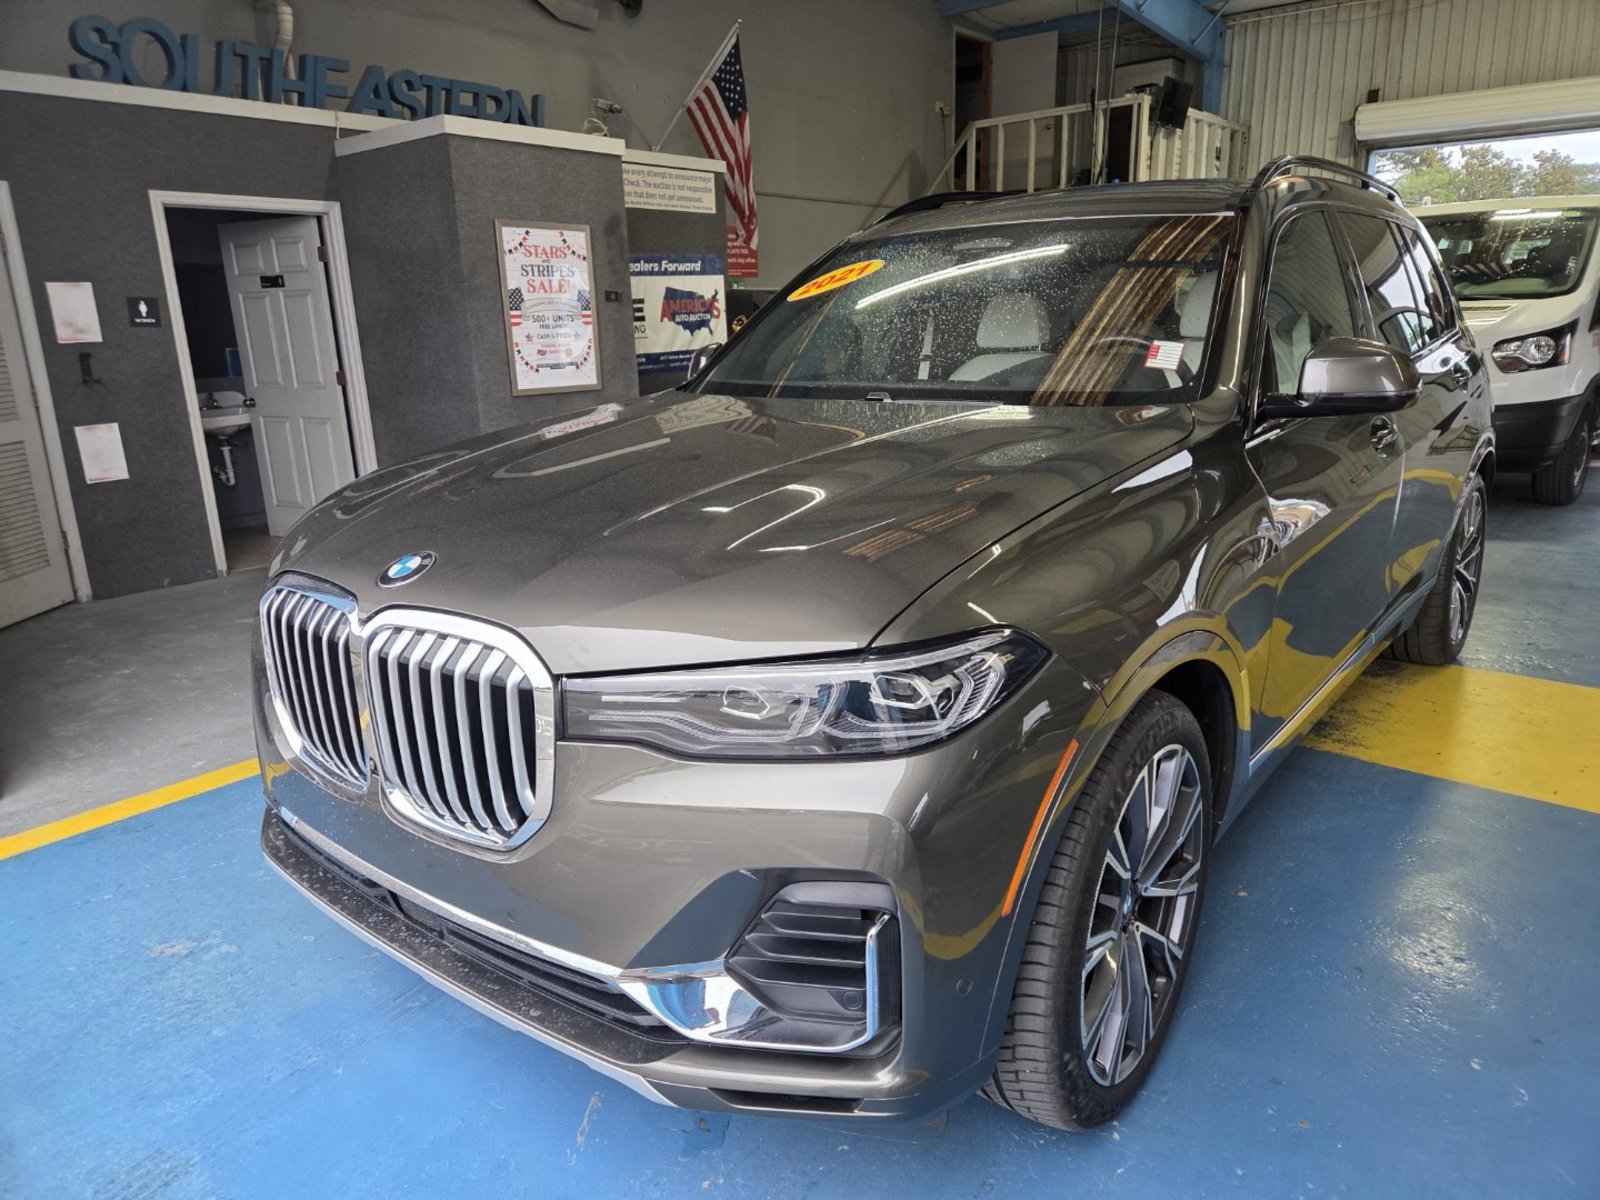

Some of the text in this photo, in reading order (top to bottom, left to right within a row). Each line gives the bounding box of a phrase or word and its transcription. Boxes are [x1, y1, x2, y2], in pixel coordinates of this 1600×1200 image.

[68, 15, 544, 127] SOUTHEASTERN
[523, 244, 567, 258] STARS
[520, 263, 575, 278] STRIPES
[661, 260, 701, 271] Forward
[796, 262, 874, 298] 2021
[552, 313, 575, 322] UNITS
